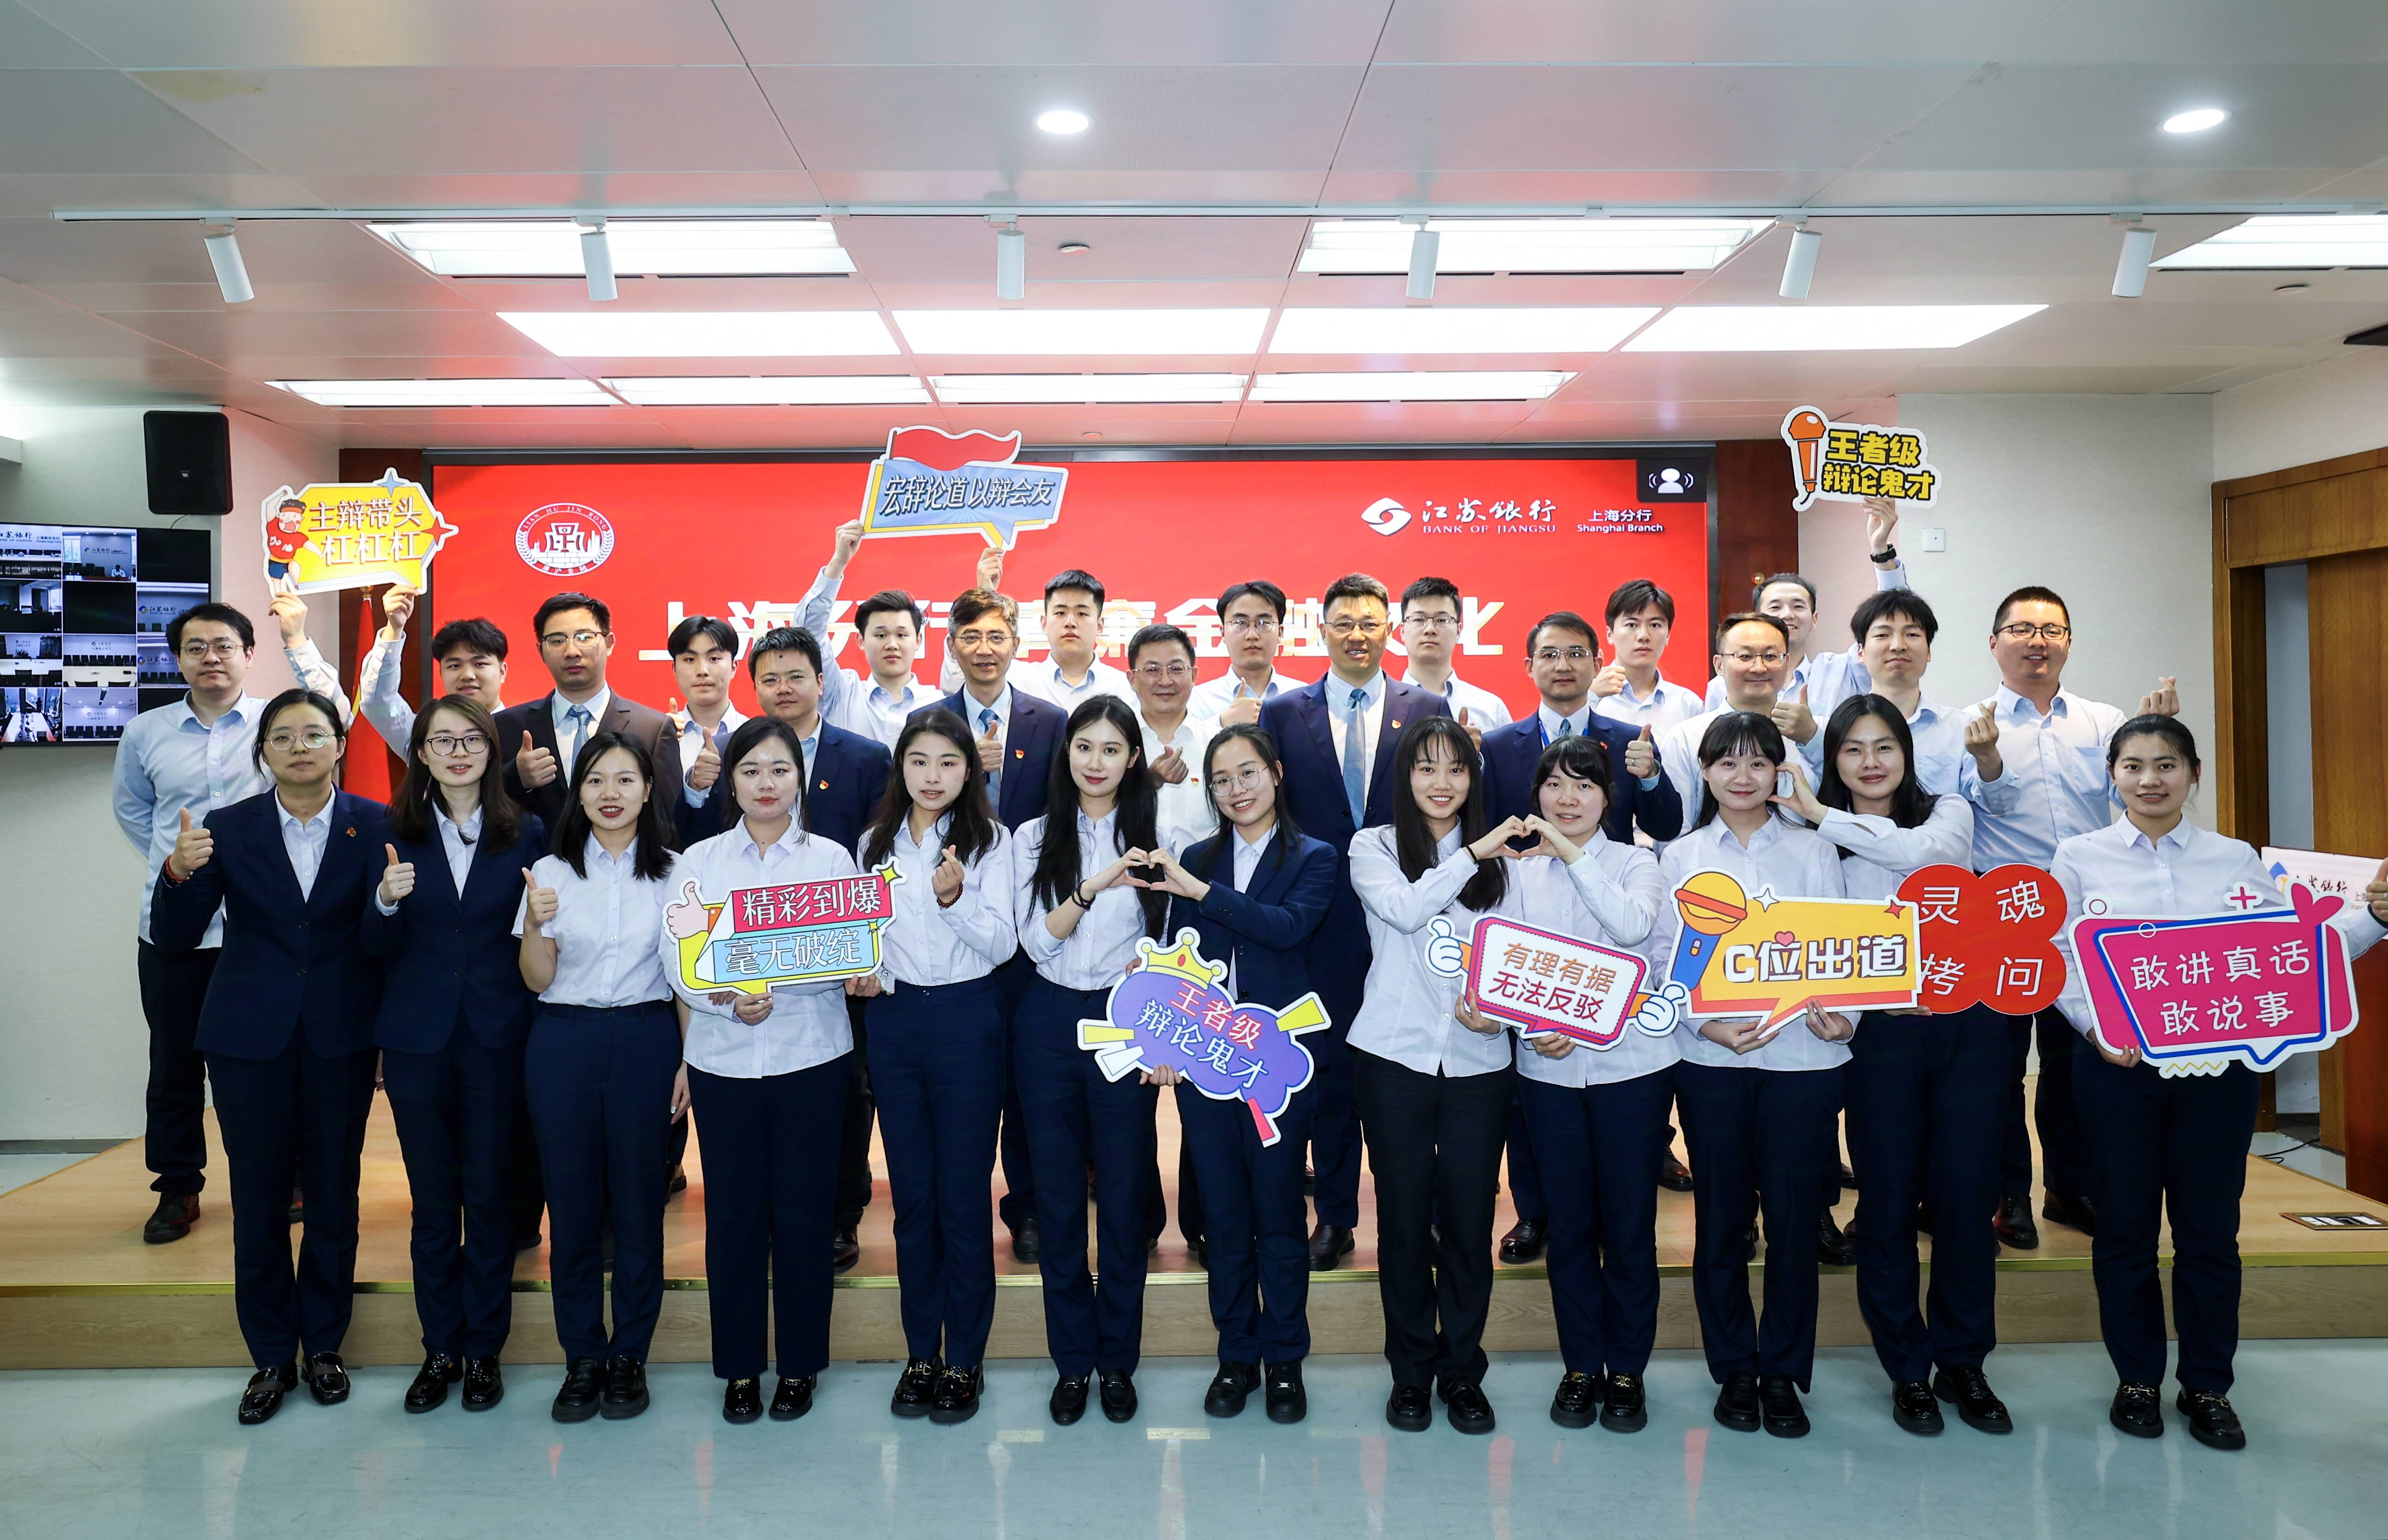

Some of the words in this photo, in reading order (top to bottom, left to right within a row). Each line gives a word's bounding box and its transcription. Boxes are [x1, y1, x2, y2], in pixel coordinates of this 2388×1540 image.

[1826, 430, 1921, 467] 王者级
[1822, 463, 1934, 500] 辩论鬼才
[308, 496, 422, 532] 主辩带头
[1497, 525, 1556, 534] JIANGSU
[1577, 523, 1625, 533] Shanghai
[1628, 523, 1663, 532] Branch
[1588, 509, 1652, 522] 上海分行
[322, 530, 423, 566] 杠杠杠
[742, 878, 881, 926] 精彩到爆
[1919, 880, 2045, 924] 灵魂
[725, 929, 862, 974] 毫无破绽
[1503, 943, 1616, 994] 有理有据
[1724, 934, 1907, 983] C位出道
[2130, 940, 2310, 990] 敢讲真话
[1170, 981, 1261, 1050] 王者级
[1488, 971, 1604, 1023] 无法反驳
[2160, 991, 2294, 1035] 敢说事
[1134, 999, 1268, 1088] 辩论鬼才
